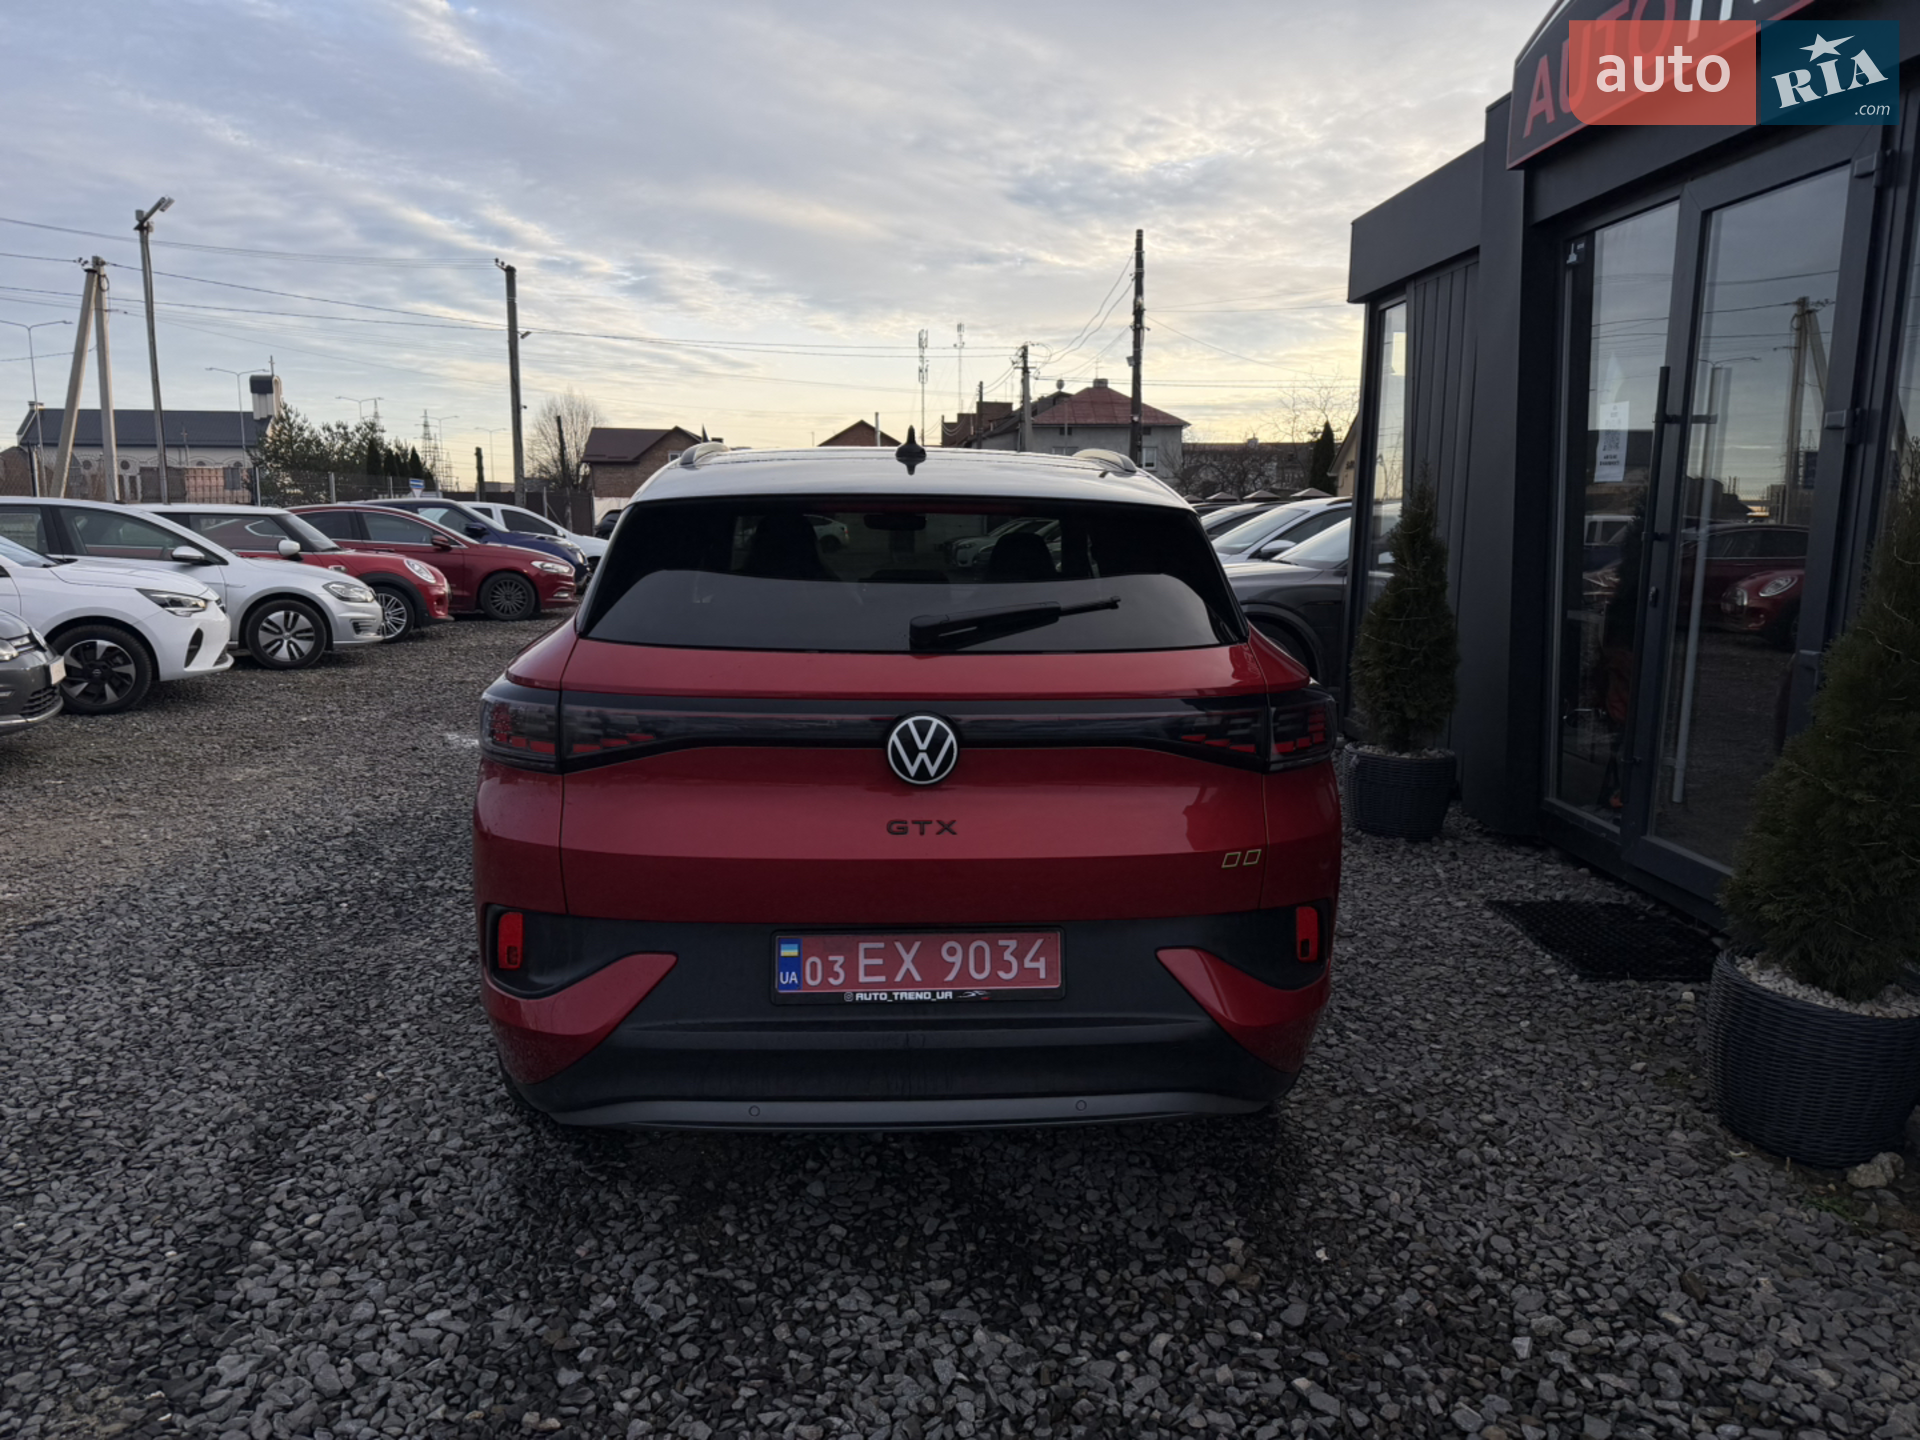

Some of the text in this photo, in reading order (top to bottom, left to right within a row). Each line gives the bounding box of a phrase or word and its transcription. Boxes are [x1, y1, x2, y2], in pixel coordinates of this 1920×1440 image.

[886, 820, 957, 836] GTX
[805, 939, 1046, 986] 03 EX 9034
[779, 972, 798, 984] UA
